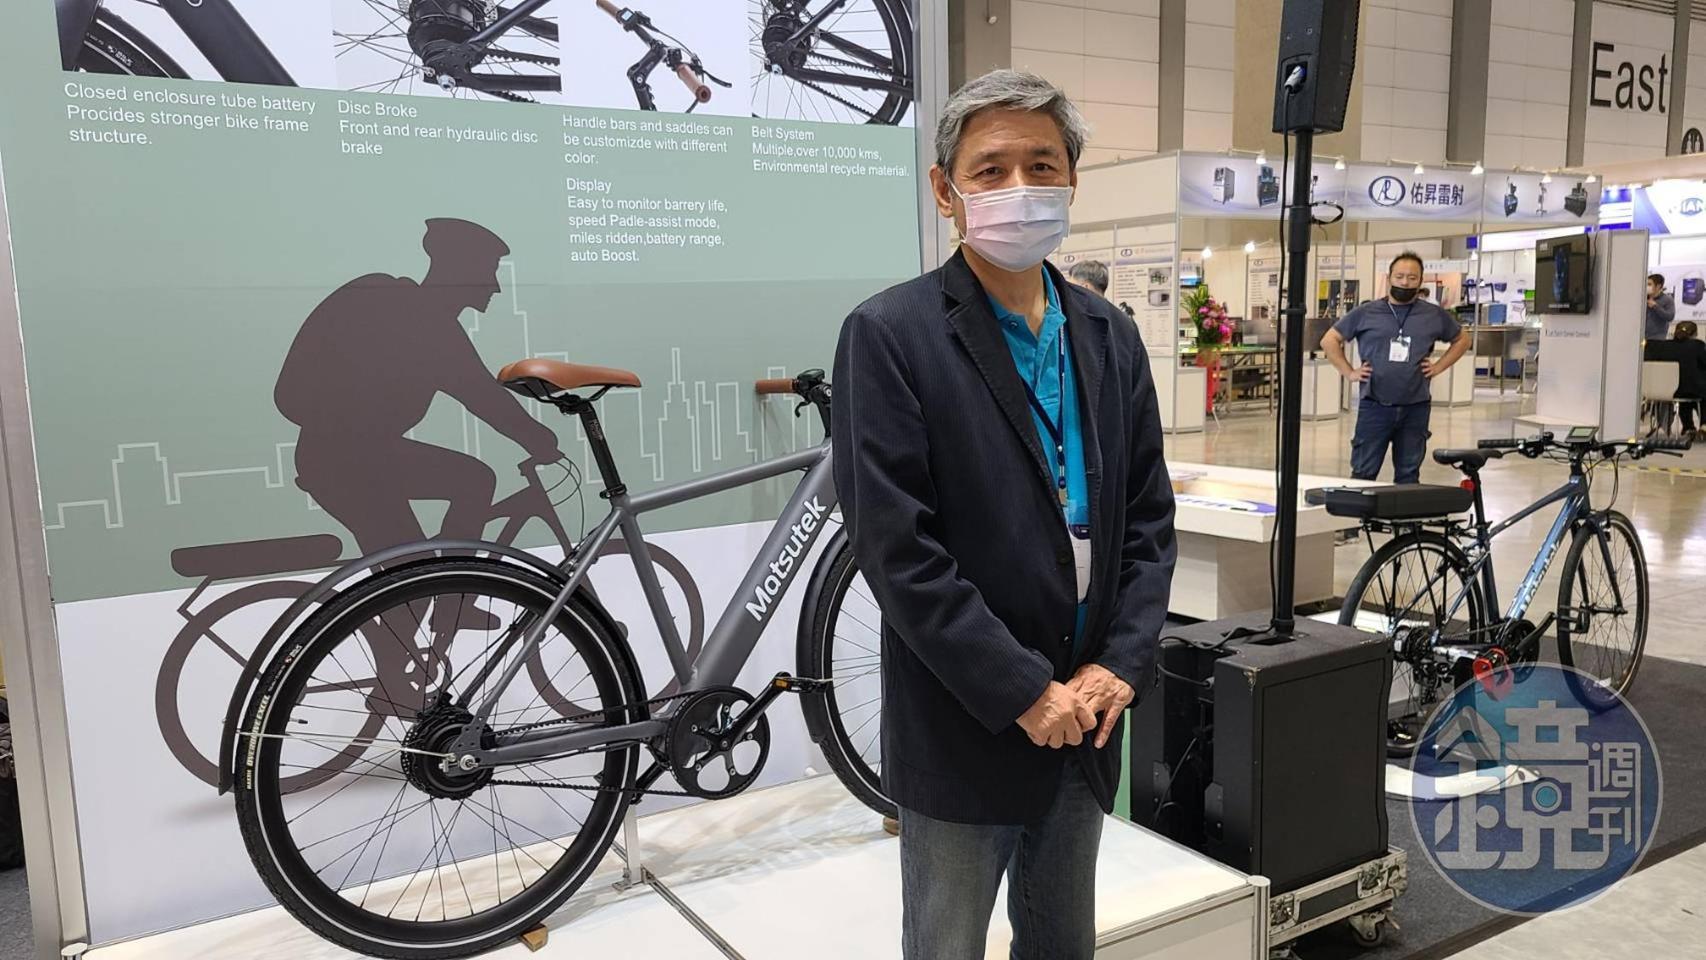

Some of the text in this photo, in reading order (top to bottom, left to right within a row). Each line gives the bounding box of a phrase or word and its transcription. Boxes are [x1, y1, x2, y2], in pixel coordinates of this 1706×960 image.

[1590, 42, 1668, 113] East
[63, 83, 316, 114] Closed enclosure tube battery
[338, 100, 371, 116] Disc
[67, 105, 309, 133] Procides stronger bike frame
[563, 115, 733, 136] Handle bars and saddles can
[70, 128, 153, 145] structure.
[340, 120, 538, 143] Front and rear hydraulic disc
[752, 126, 814, 141] Belt System
[342, 140, 383, 154] brake
[564, 132, 727, 153] be customizde with different
[753, 160, 828, 174] Environmental
[831, 163, 865, 176] recycle
[566, 178, 612, 194] Display
[1410, 182, 1464, 206] 佑昇雷射
[568, 196, 598, 210] Easy
[602, 197, 614, 210] to
[617, 198, 661, 212] monitor
[664, 200, 705, 214] barrery
[569, 214, 606, 229] speed
[610, 215, 682, 229] Padle-assist
[570, 232, 602, 245] miles
[571, 249, 640, 262] auto Boost.
[745, 495, 827, 622] Matsutek
